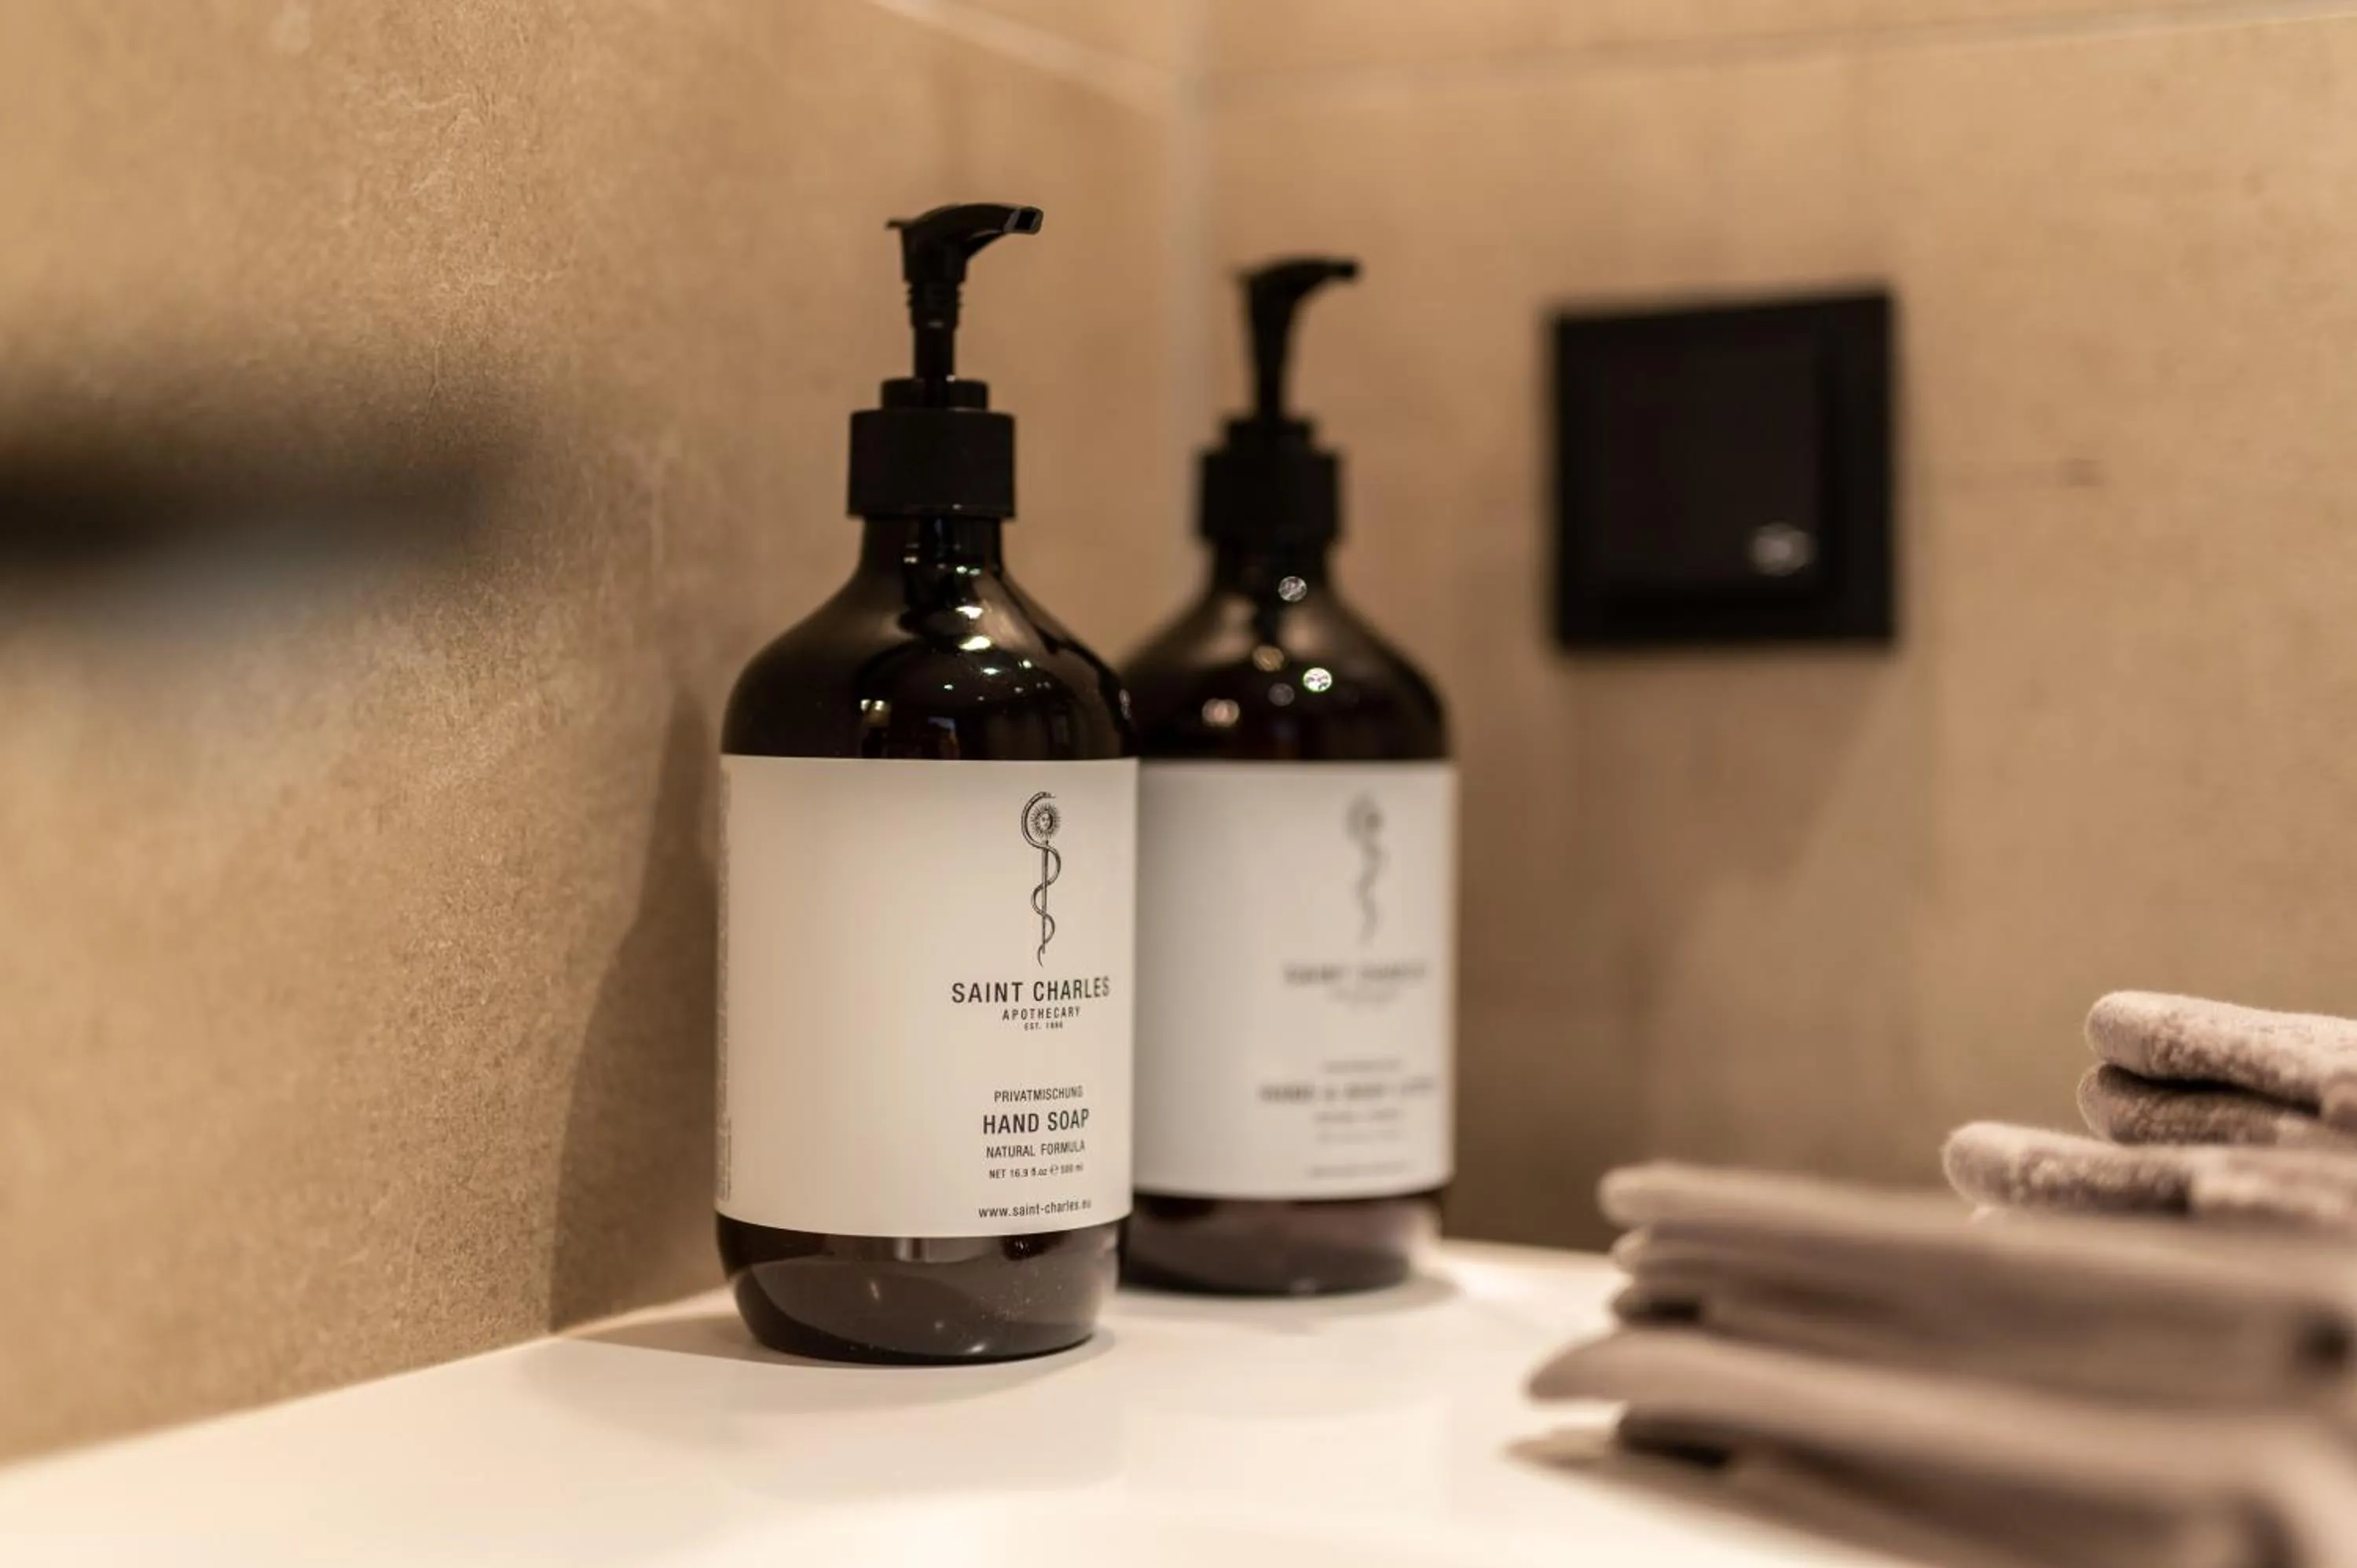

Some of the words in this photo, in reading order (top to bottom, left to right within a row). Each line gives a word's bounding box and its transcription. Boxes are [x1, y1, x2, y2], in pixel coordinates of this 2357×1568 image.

[951, 981, 1024, 1003] SAINT
[1032, 976, 1110, 1002] CHARLES
[1002, 1006, 1080, 1020] APOTHECARY
[994, 1086, 1083, 1102] PRIVATMISCHUNG
[983, 1113, 1039, 1134] HAND
[1047, 1108, 1090, 1131] SOAP
[986, 1145, 1036, 1159] NATURAL
[1040, 1139, 1085, 1156] FORMULA
[988, 1168, 1006, 1179] NET
[1010, 1167, 1029, 1178] 16.9
[978, 1199, 1091, 1218] www.saint-charles.eu
